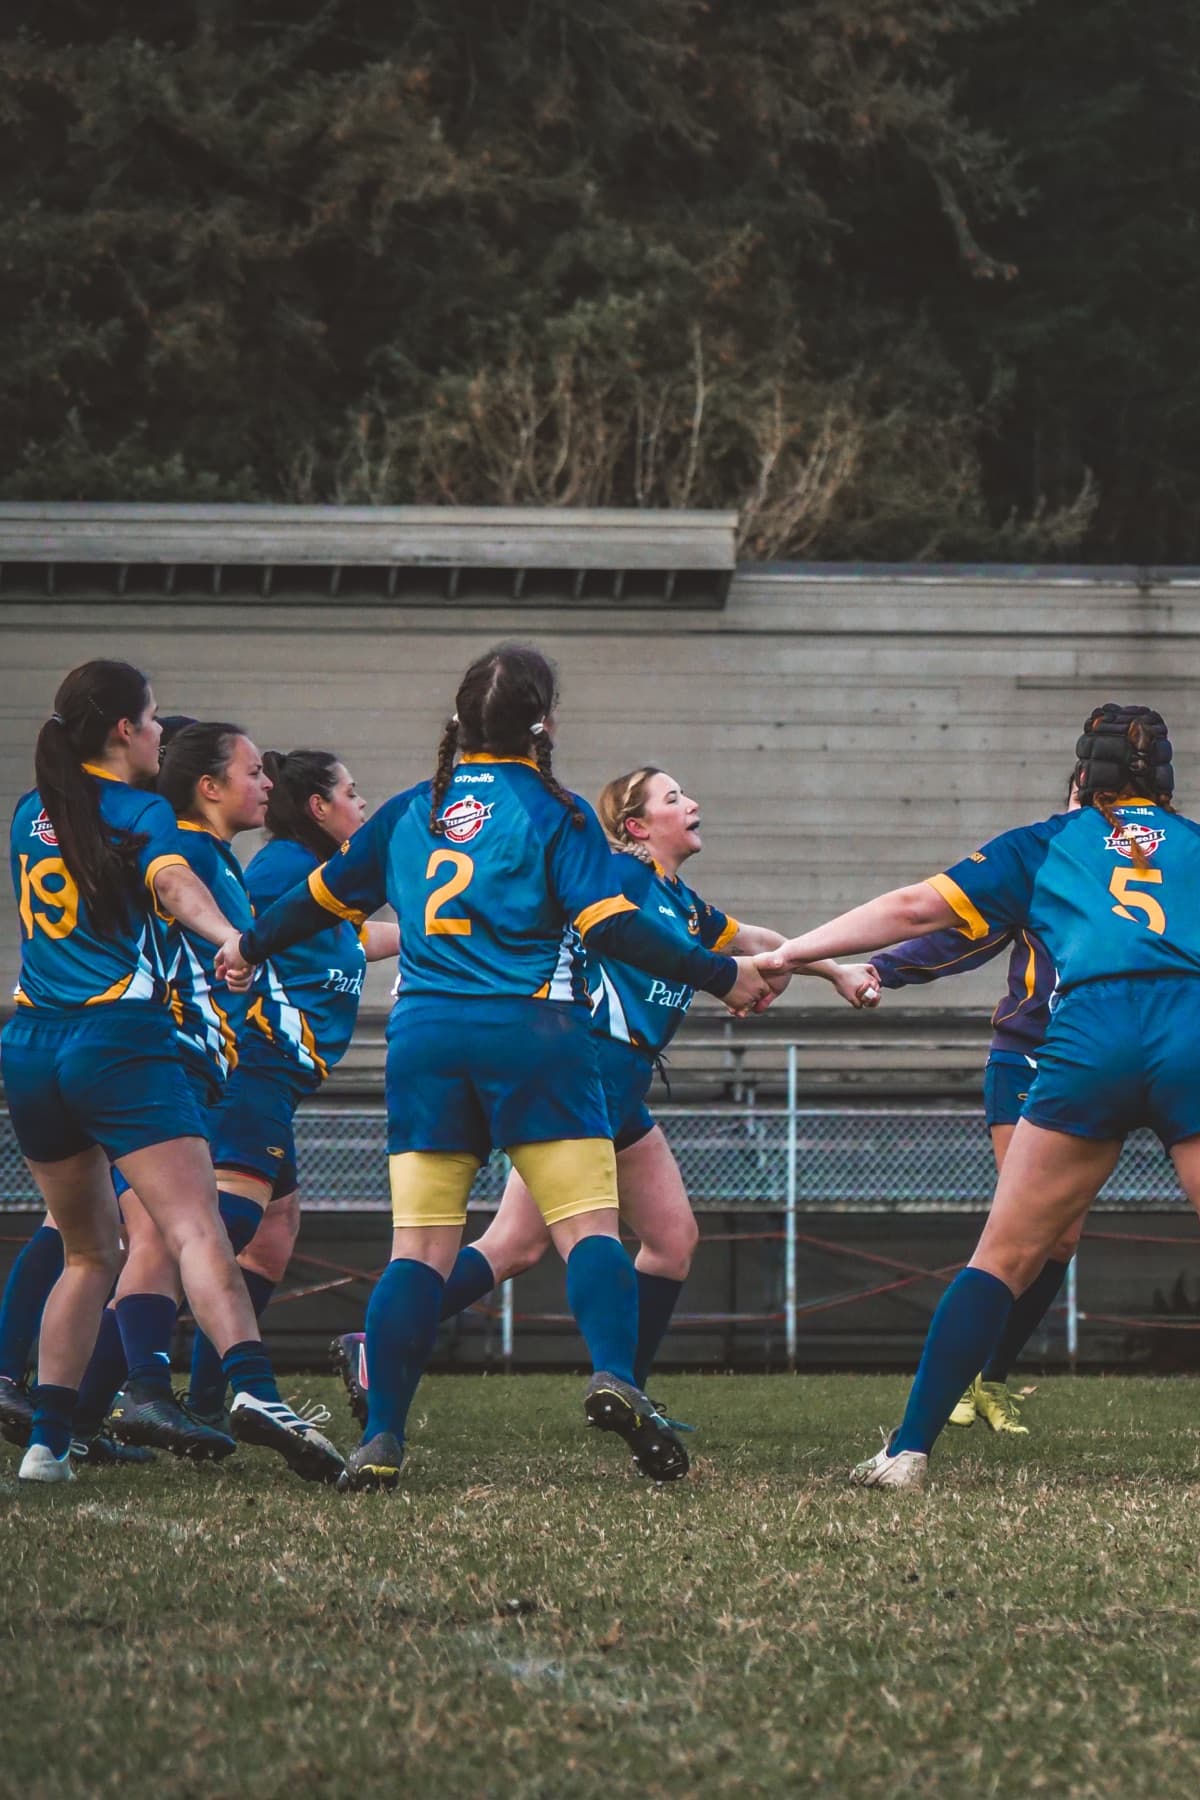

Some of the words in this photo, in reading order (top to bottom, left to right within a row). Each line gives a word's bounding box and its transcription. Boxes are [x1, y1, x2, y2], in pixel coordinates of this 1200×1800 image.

[19, 853, 79, 940] 19
[424, 848, 475, 937] 2
[1108, 866, 1167, 936] 5
